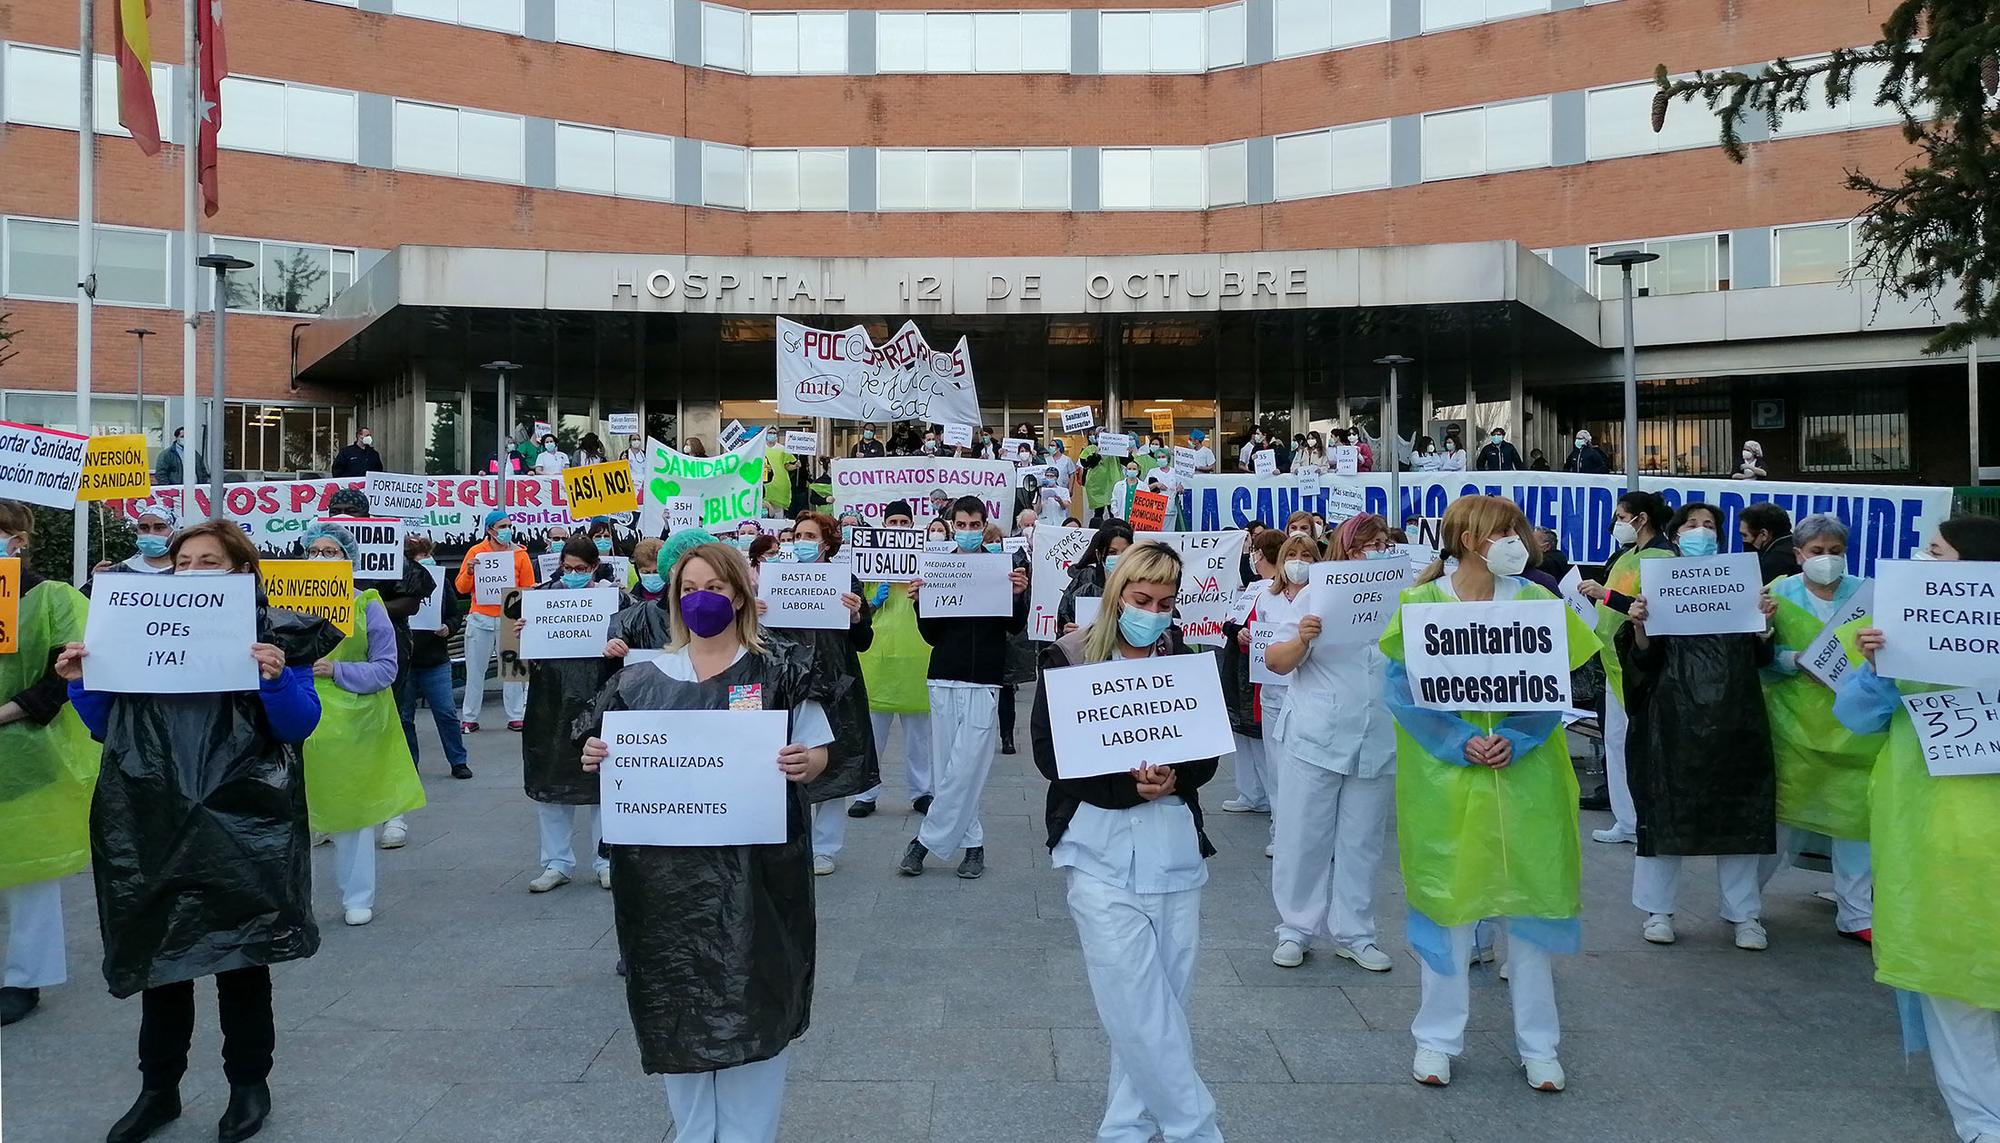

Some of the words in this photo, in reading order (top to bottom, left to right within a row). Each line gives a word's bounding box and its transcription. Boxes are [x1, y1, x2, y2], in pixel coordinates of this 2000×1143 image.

[612, 267, 846, 301] HOSPITAL
[899, 276, 942, 300] 12
[986, 275, 1041, 299] DE
[1085, 267, 1308, 298] OCTUBRE
[800, 379, 841, 397] mats
[1757, 402, 1778, 426] P
[0, 434, 29, 454] ortar
[32, 435, 83, 466] Sanidad,
[85, 447, 144, 467] NVERSIÓN,
[654, 447, 740, 479] SANIDAD
[35, 468, 79, 492] mortal!
[93, 472, 146, 489] SANIDAD!
[838, 468, 935, 486] CONTRATOS
[938, 468, 1007, 488] BASURA
[372, 479, 424, 494] FORTALECE
[570, 470, 602, 508] ¡ASÍ,
[603, 472, 631, 497] NO!
[369, 495, 380, 506] TU
[674, 502, 693, 511] 35H
[1134, 496, 1165, 511] RECORTES
[420, 510, 462, 527] alud
[672, 518, 693, 527] ¡YA!
[853, 531, 871, 547] SE
[876, 531, 925, 549] VENDE
[1045, 529, 1083, 561] GESTORES
[485, 559, 500, 569] 35
[855, 552, 873, 574] TU
[875, 553, 920, 575] SALUD.
[924, 561, 957, 569] MEDIDAS
[957, 561, 967, 569] DE
[1207, 556, 1226, 570] DE
[478, 575, 508, 584] HORAS
[781, 573, 812, 582] BASTA
[814, 573, 827, 582] DE
[1325, 568, 1404, 586] RESOLUCION
[1672, 568, 1711, 580] BASTA
[1714, 566, 1730, 577] DE
[286, 575, 350, 601] INVERSIÓN,
[485, 587, 501, 597] ¡YA
[771, 587, 837, 596] PRECARIEDAD
[1193, 575, 1220, 594] YA
[1659, 583, 1745, 597] PRECARIEDAD
[1925, 582, 1995, 598] BASTA
[109, 591, 224, 608] RESOLUCION
[546, 600, 578, 609] BASTA
[580, 599, 593, 608] DE
[934, 594, 964, 608] ¡YA!
[1353, 591, 1383, 604] OPEs
[782, 602, 825, 610] LABORAL
[1674, 601, 1732, 614] LABORAL
[535, 614, 604, 625] PRECARIEDAD
[1351, 611, 1378, 625] ¡YA!
[146, 621, 190, 637] OPEs
[547, 629, 592, 639] LABORAL
[1424, 621, 1553, 656] Sanitarios
[1928, 636, 2000, 655] LABOR
[148, 650, 186, 667] ¡YA!
[1092, 677, 1148, 696] BASTA
[1152, 674, 1175, 689] DE
[1420, 670, 1566, 704] necesarios.
[1076, 697, 1198, 724] PRECARIEDAD
[1908, 694, 1961, 713] POR
[1922, 708, 1978, 739] 35
[616, 733, 668, 745] BOLSAS
[1101, 725, 1183, 747] LABORAL
[1928, 740, 2000, 761] SEMAN
[615, 756, 724, 768] CENTRALIZADAS
[615, 779, 623, 790] Y
[615, 802, 728, 815] TRANSPARENTES
